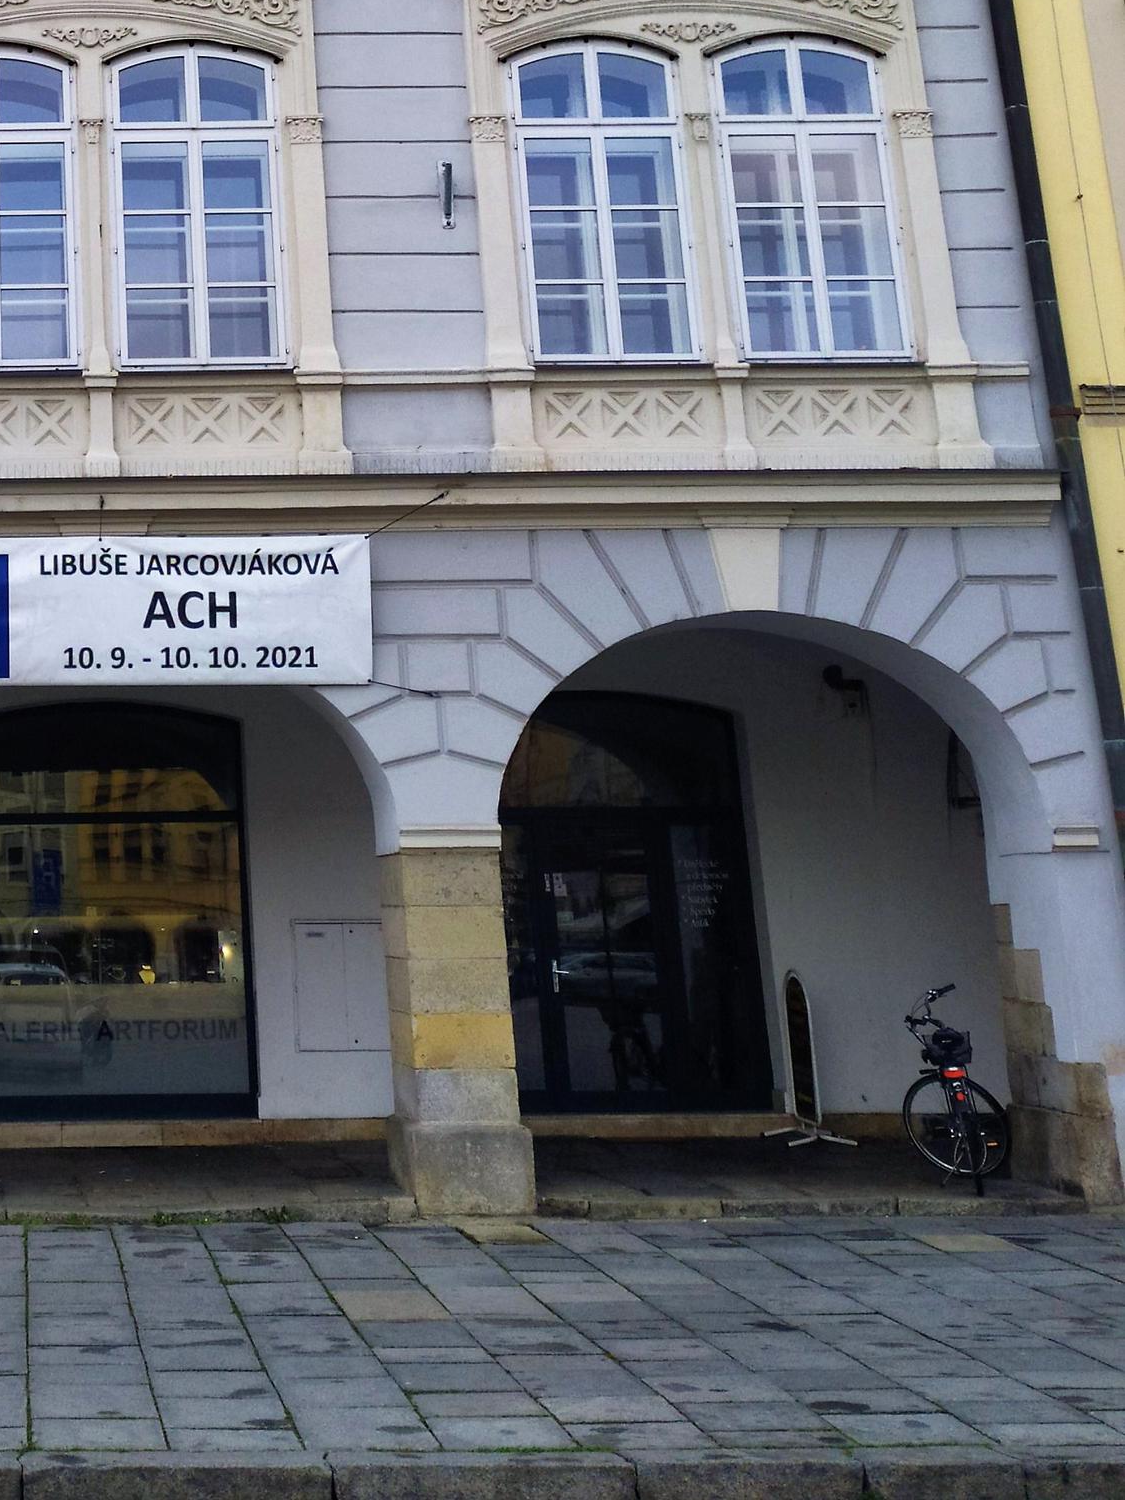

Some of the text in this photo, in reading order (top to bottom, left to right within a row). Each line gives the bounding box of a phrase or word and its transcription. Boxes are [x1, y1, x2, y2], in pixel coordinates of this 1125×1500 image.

[39, 546, 340, 576] LIBUŠE JARCOVJÁKOVÁ
[142, 590, 238, 630] ACH
[63, 646, 102, 670] 10.
[110, 646, 134, 669] 9.
[160, 646, 199, 669] 10.
[208, 646, 247, 669] 10.
[255, 645, 319, 669] 2021
[96, 1018, 238, 1042] ARTFORUM
